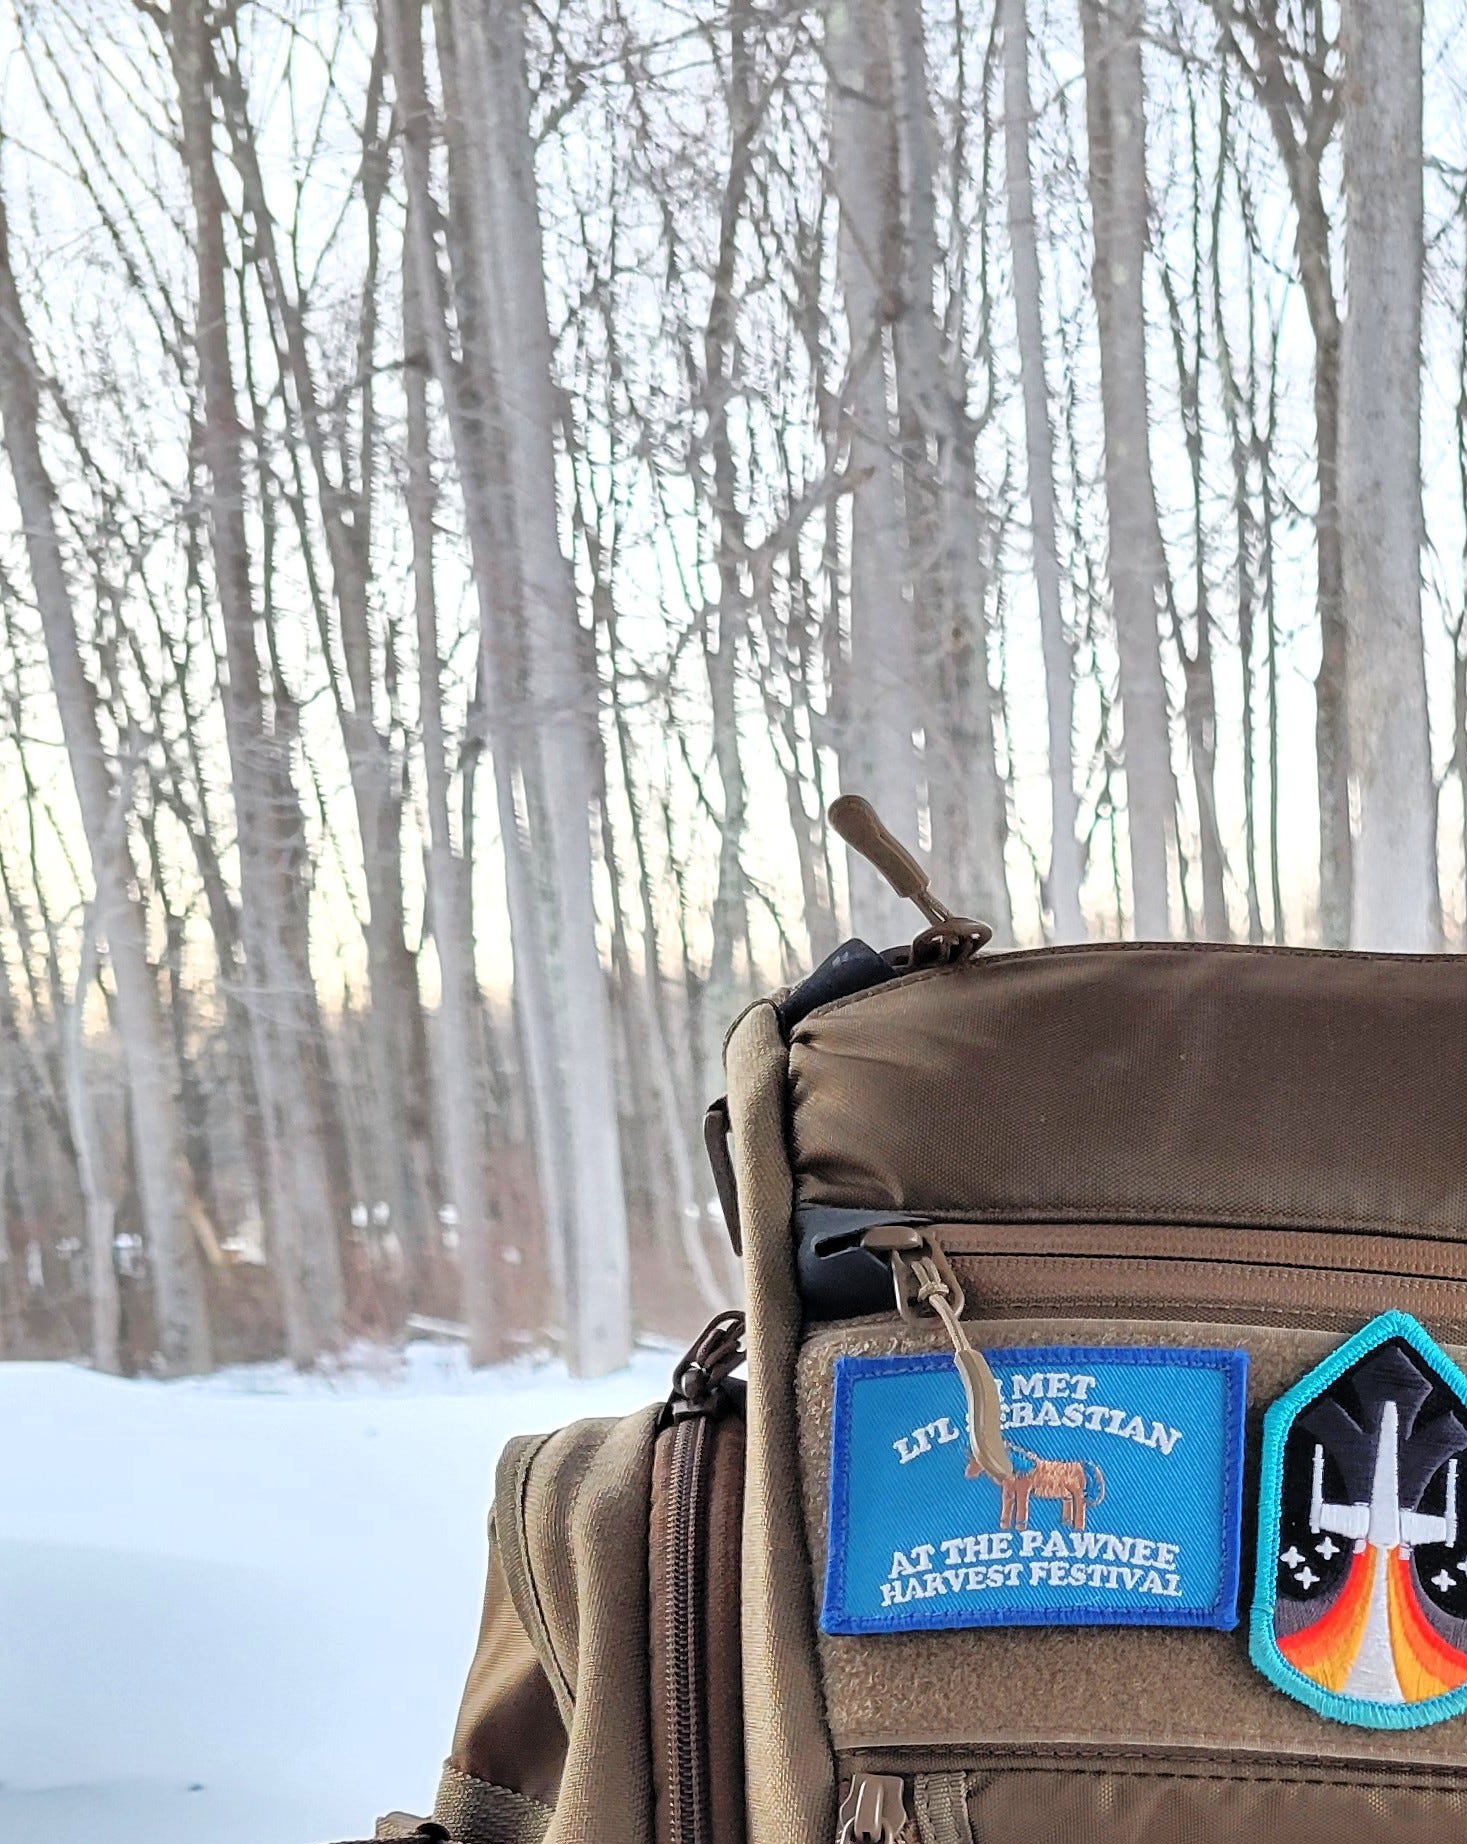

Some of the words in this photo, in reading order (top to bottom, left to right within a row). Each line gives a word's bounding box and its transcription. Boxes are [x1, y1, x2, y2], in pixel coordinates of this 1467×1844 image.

[1011, 1372, 1096, 1400] MET
[892, 1416, 960, 1465] LI'L
[965, 1399, 1184, 1456] EBASTIAN
[887, 1543, 935, 1580] AT
[940, 1531, 1014, 1566] THE
[1018, 1529, 1180, 1571] PAWNEE
[879, 1562, 1025, 1607] HARVEST
[1028, 1560, 1183, 1598] FESTIVAL
